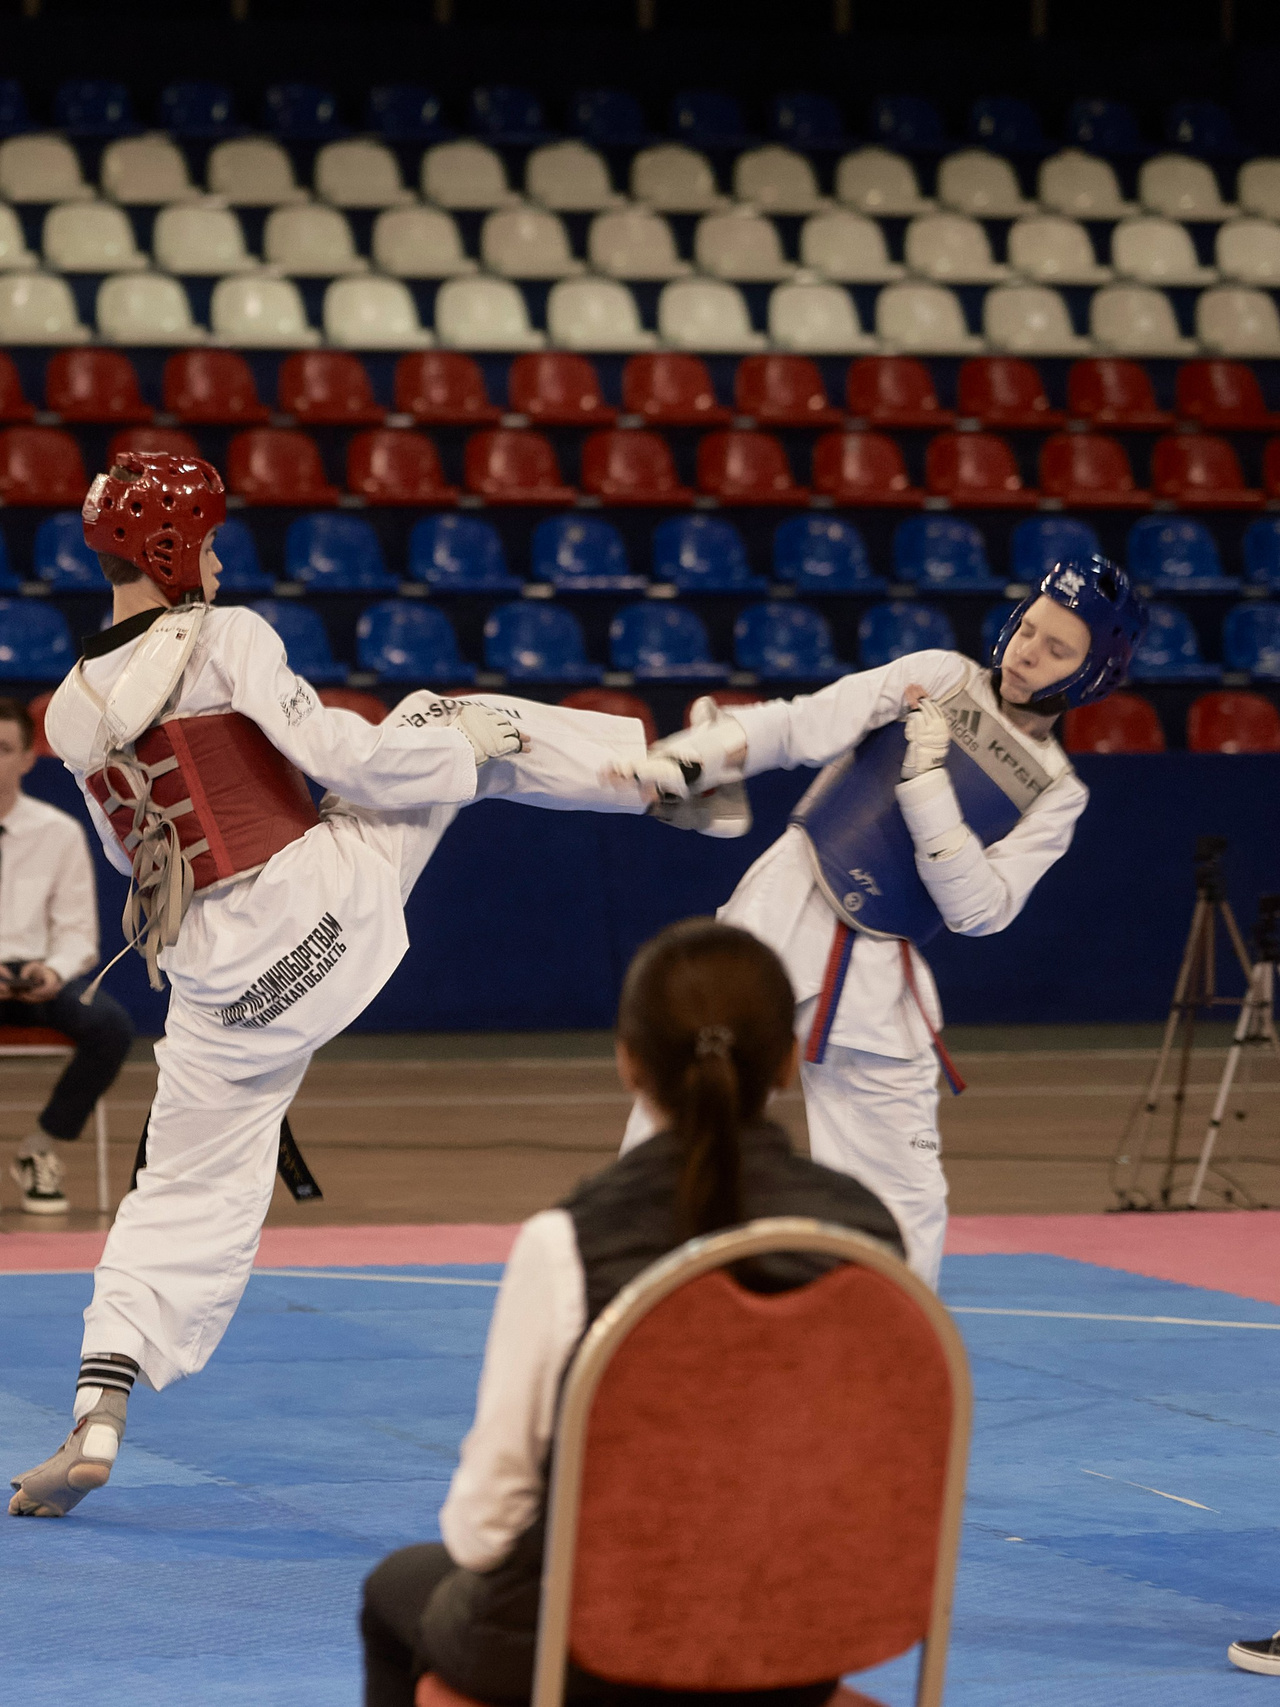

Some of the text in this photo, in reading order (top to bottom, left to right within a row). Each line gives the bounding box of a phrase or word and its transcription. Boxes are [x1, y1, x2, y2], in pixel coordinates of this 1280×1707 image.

[944, 713, 980, 752] didas
[251, 911, 343, 1005] ЕДИНОБОРСТВАМ
[301, 941, 347, 989] ОБЛАСТЬ
